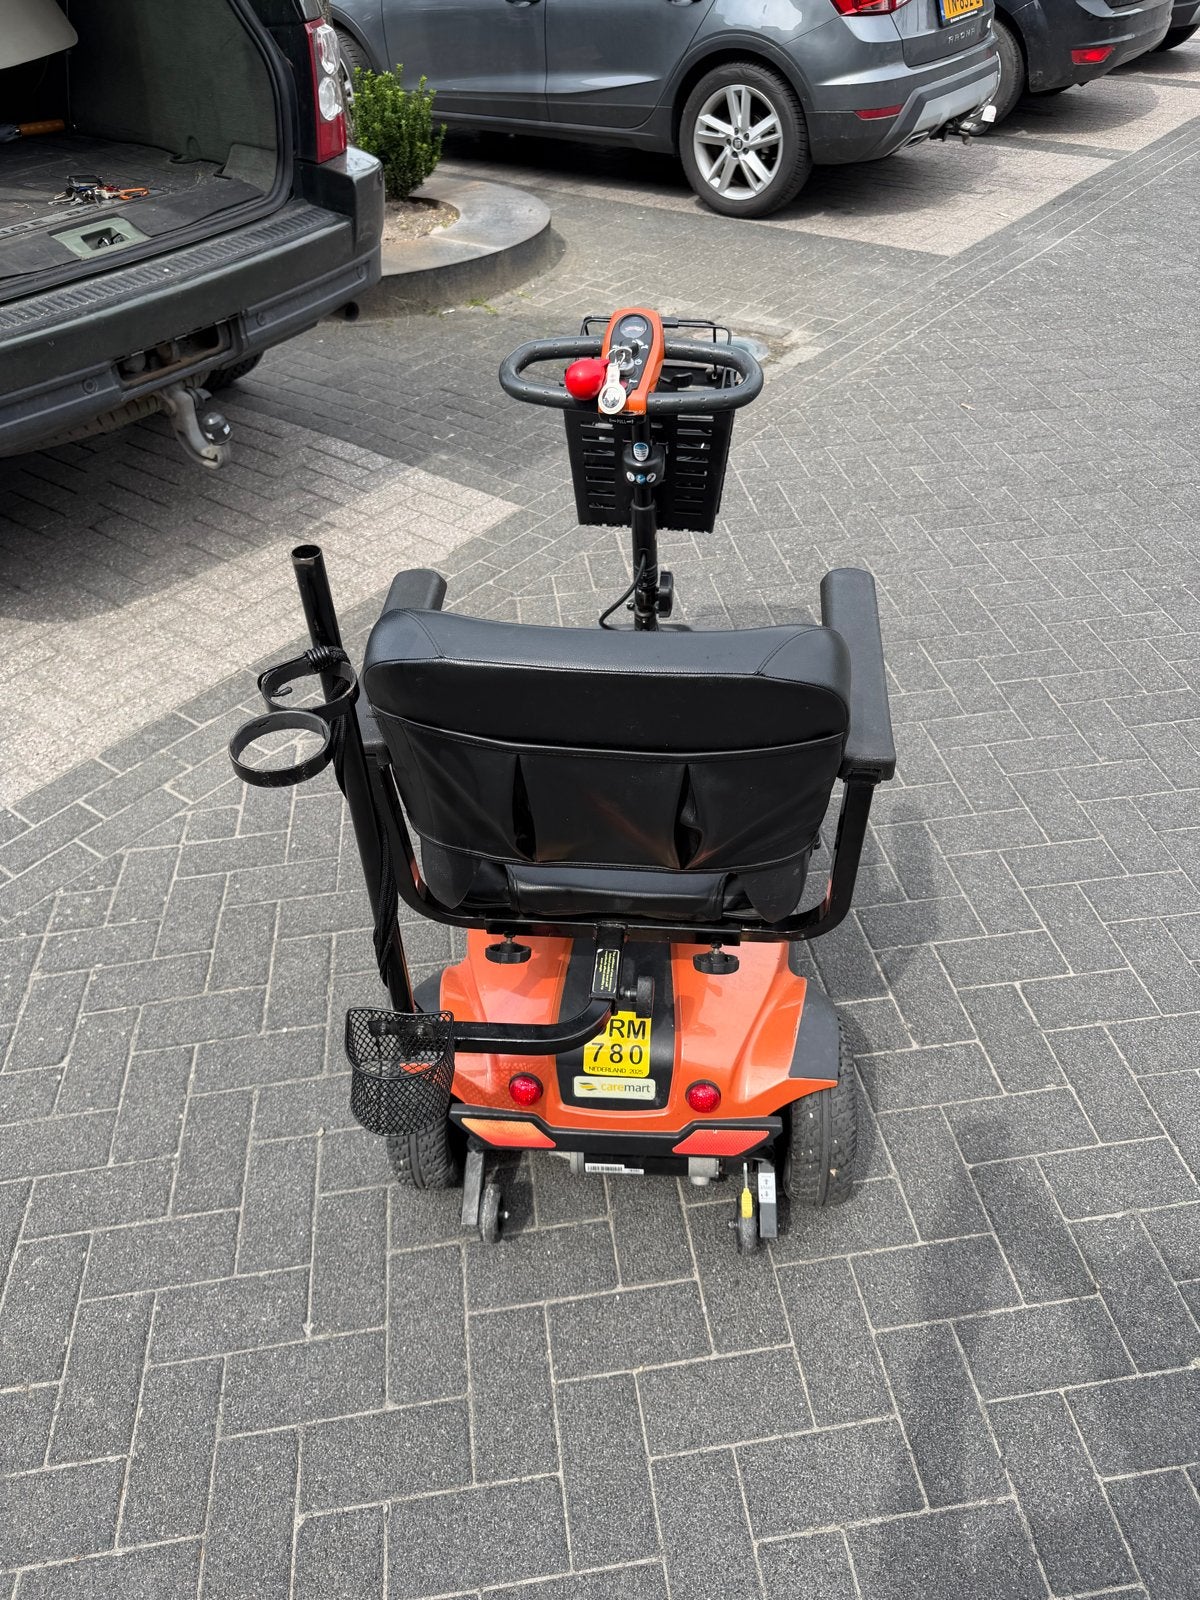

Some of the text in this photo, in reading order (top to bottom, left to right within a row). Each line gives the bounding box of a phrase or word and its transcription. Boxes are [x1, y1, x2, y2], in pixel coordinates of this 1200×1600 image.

[599, 1018, 647, 1040] RM
[591, 1043, 643, 1065] 780
[588, 1066, 627, 1074] NEDERLAND
[601, 1083, 651, 1093] caremart
